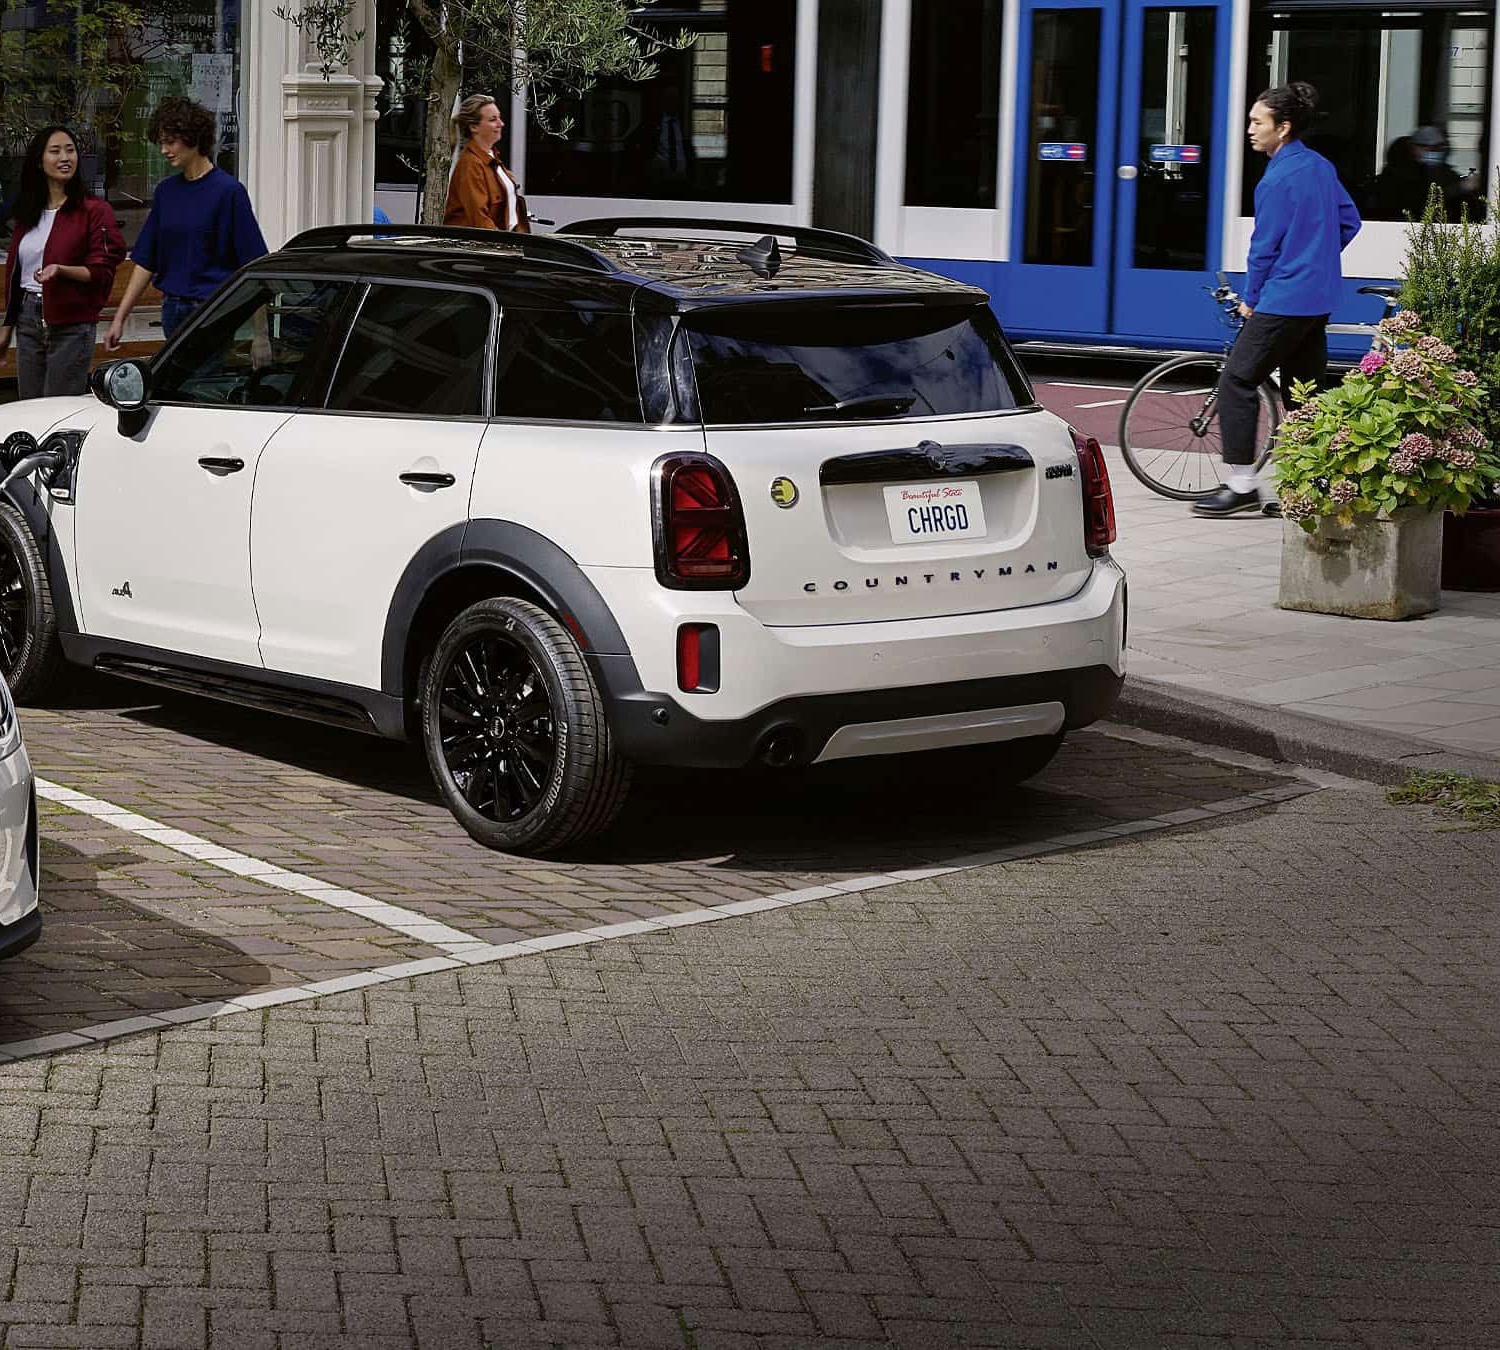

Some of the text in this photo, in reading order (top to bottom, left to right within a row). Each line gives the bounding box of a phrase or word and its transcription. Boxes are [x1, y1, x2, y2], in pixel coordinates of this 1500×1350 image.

[901, 489, 941, 503] Beautiful
[907, 504, 969, 534] CHRGD
[803, 561, 1058, 592] COUNTRYMAN
[9, 631, 34, 689] BRIDGESTO
[543, 720, 569, 814] BRIDGESTONE
